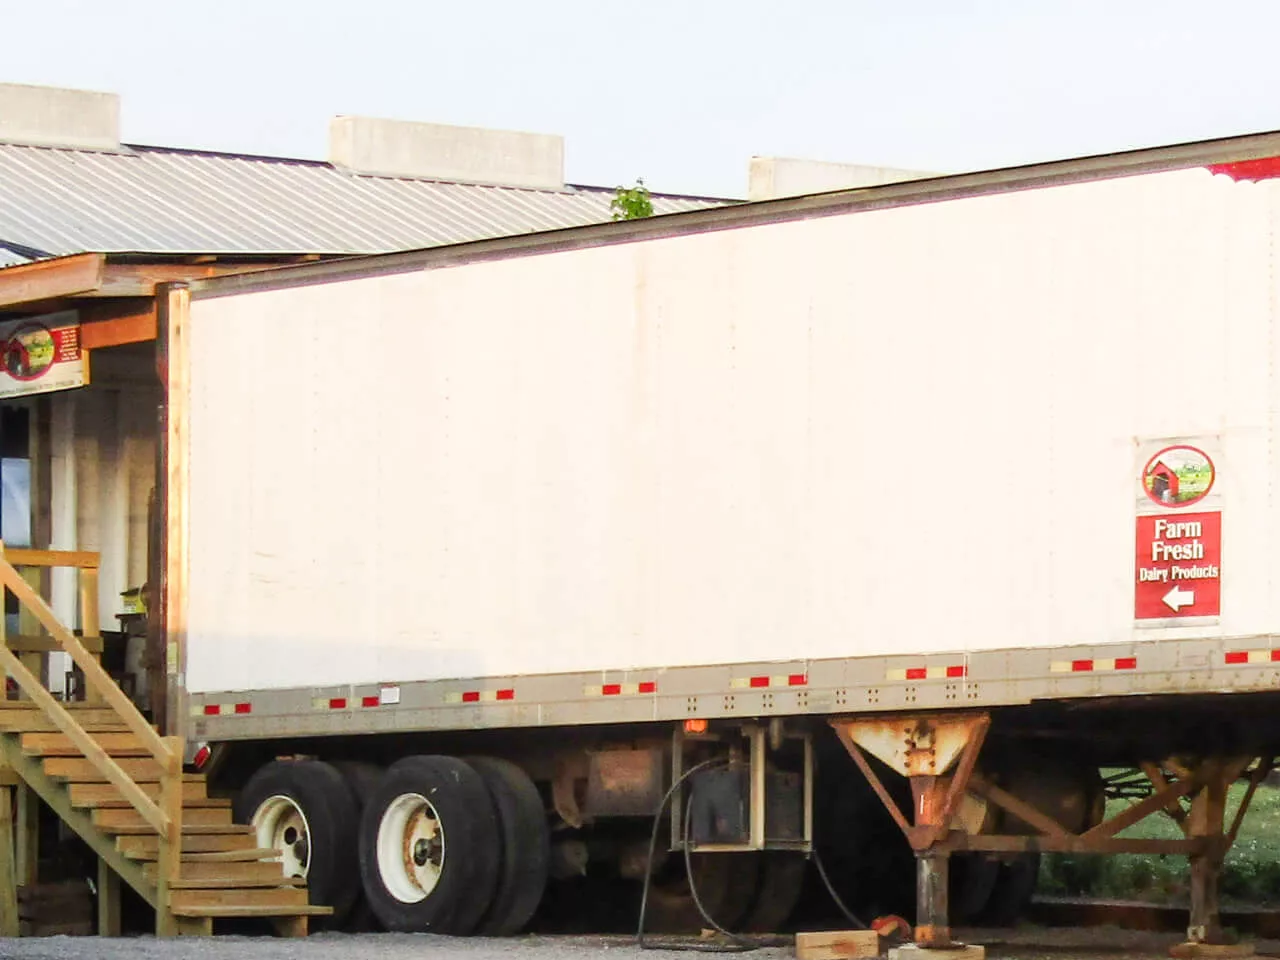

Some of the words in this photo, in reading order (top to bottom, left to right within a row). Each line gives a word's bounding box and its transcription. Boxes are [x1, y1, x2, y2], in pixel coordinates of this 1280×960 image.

[1153, 518, 1202, 540] Farm
[1151, 539, 1205, 562] Fresh
[1139, 566, 1169, 583] Dairy
[1171, 563, 1219, 580] Products
